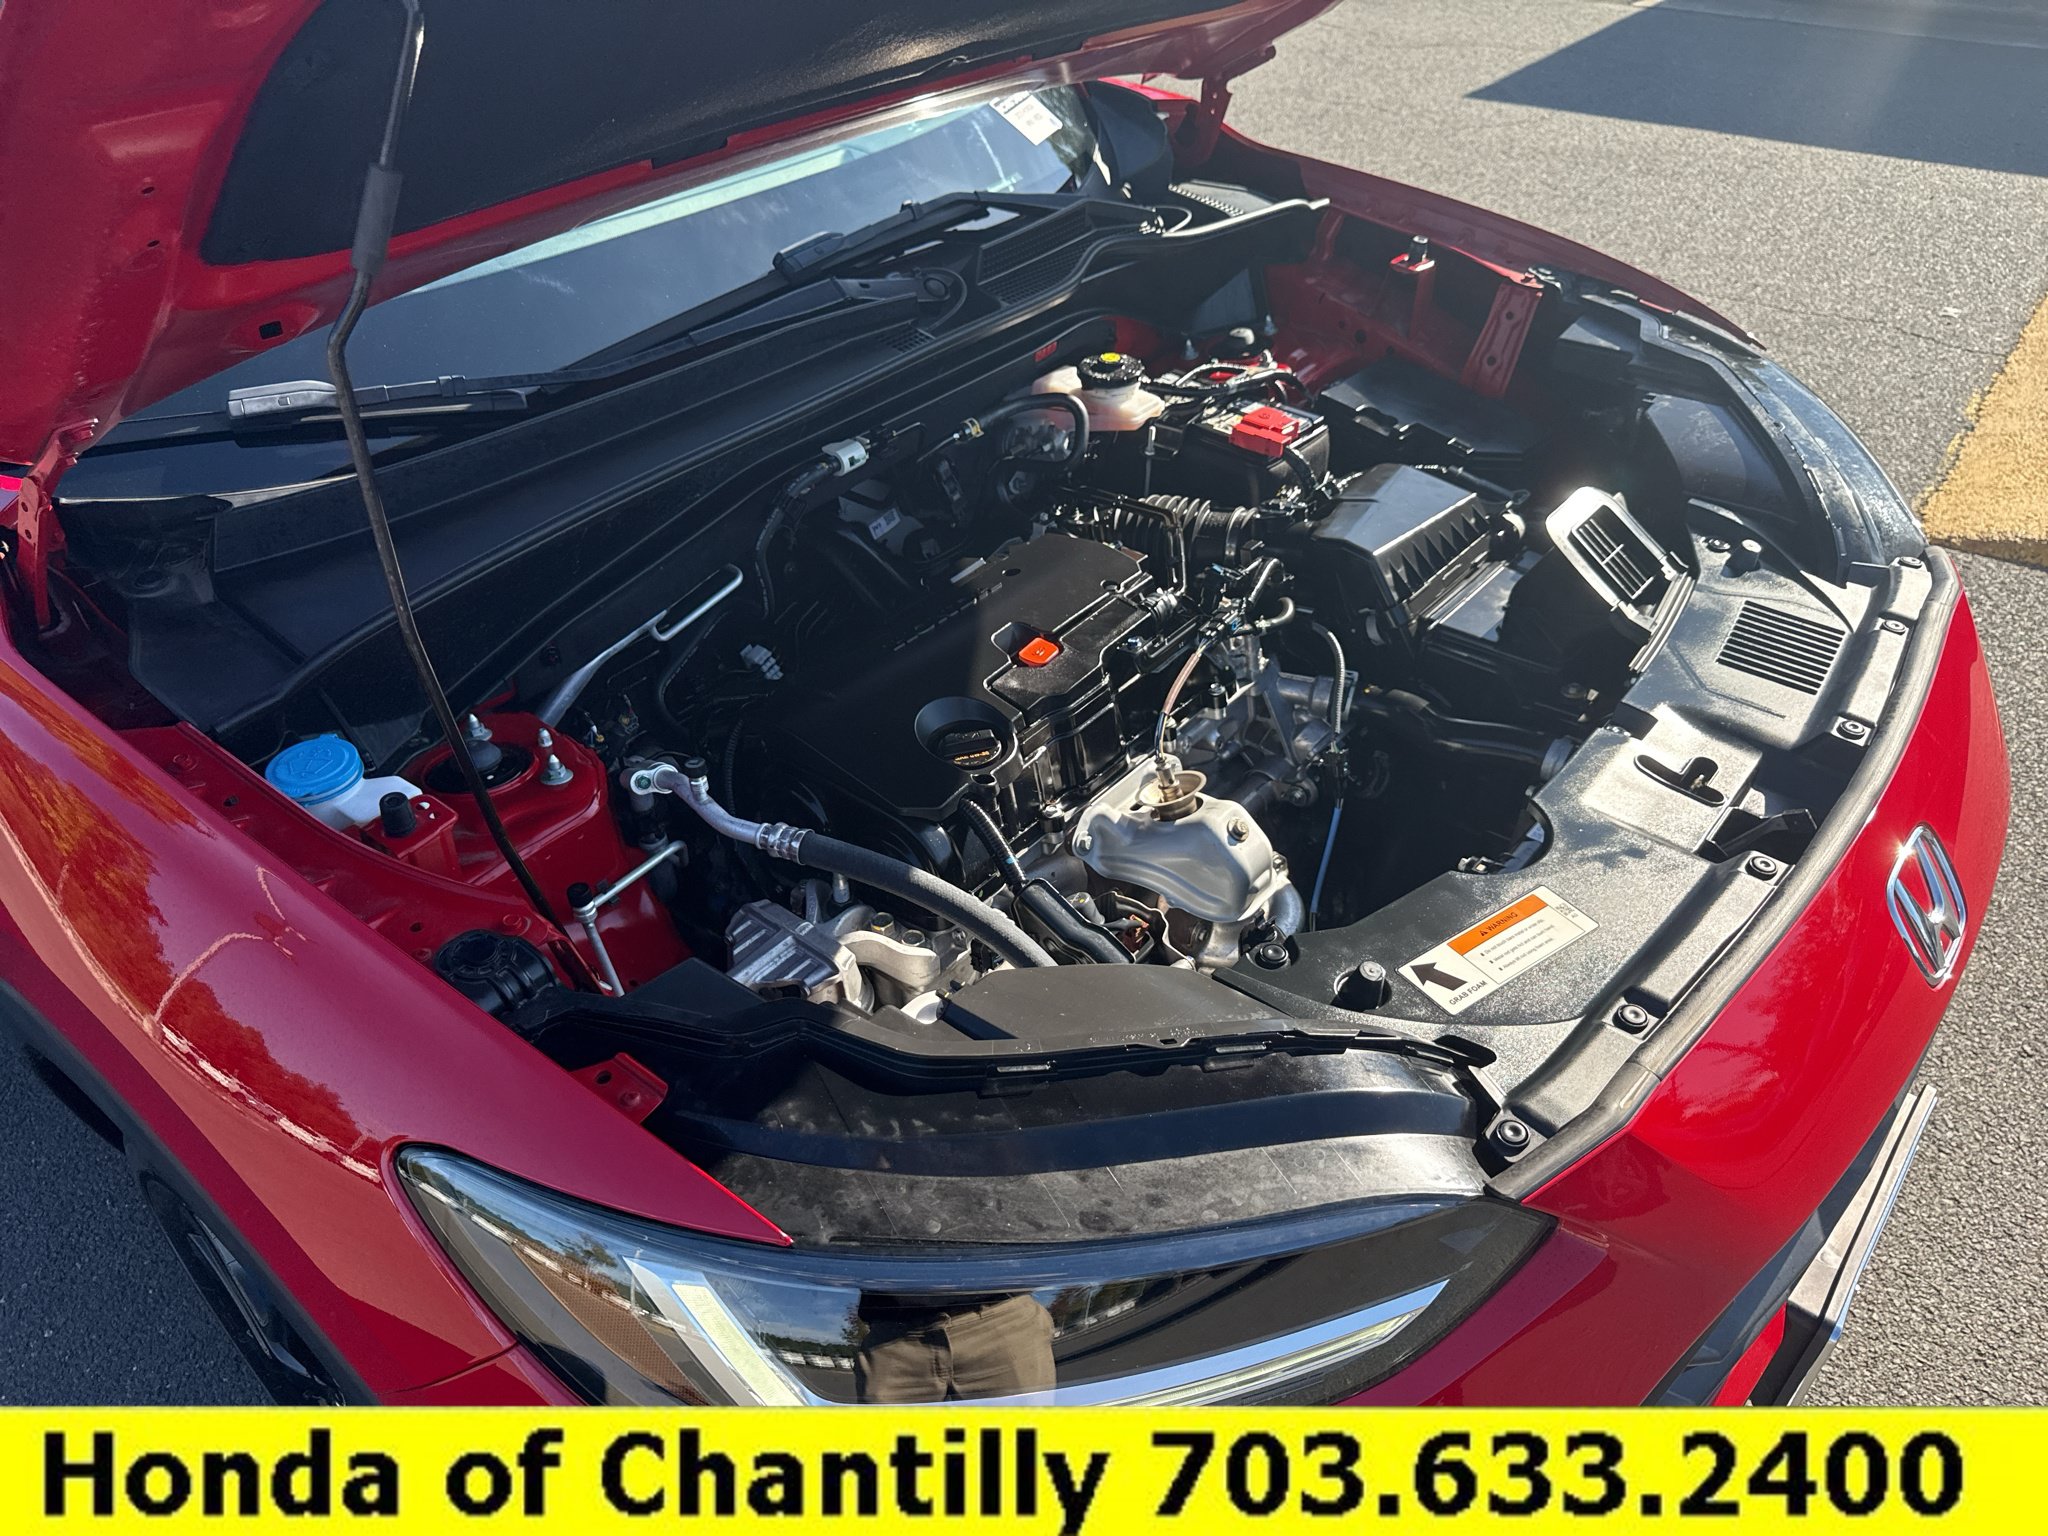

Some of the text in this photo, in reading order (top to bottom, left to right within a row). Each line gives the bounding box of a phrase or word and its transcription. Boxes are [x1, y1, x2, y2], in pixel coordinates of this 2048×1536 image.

[1486, 911, 1518, 931] WARNING
[1449, 980, 1488, 1005] GRAB FOAM
